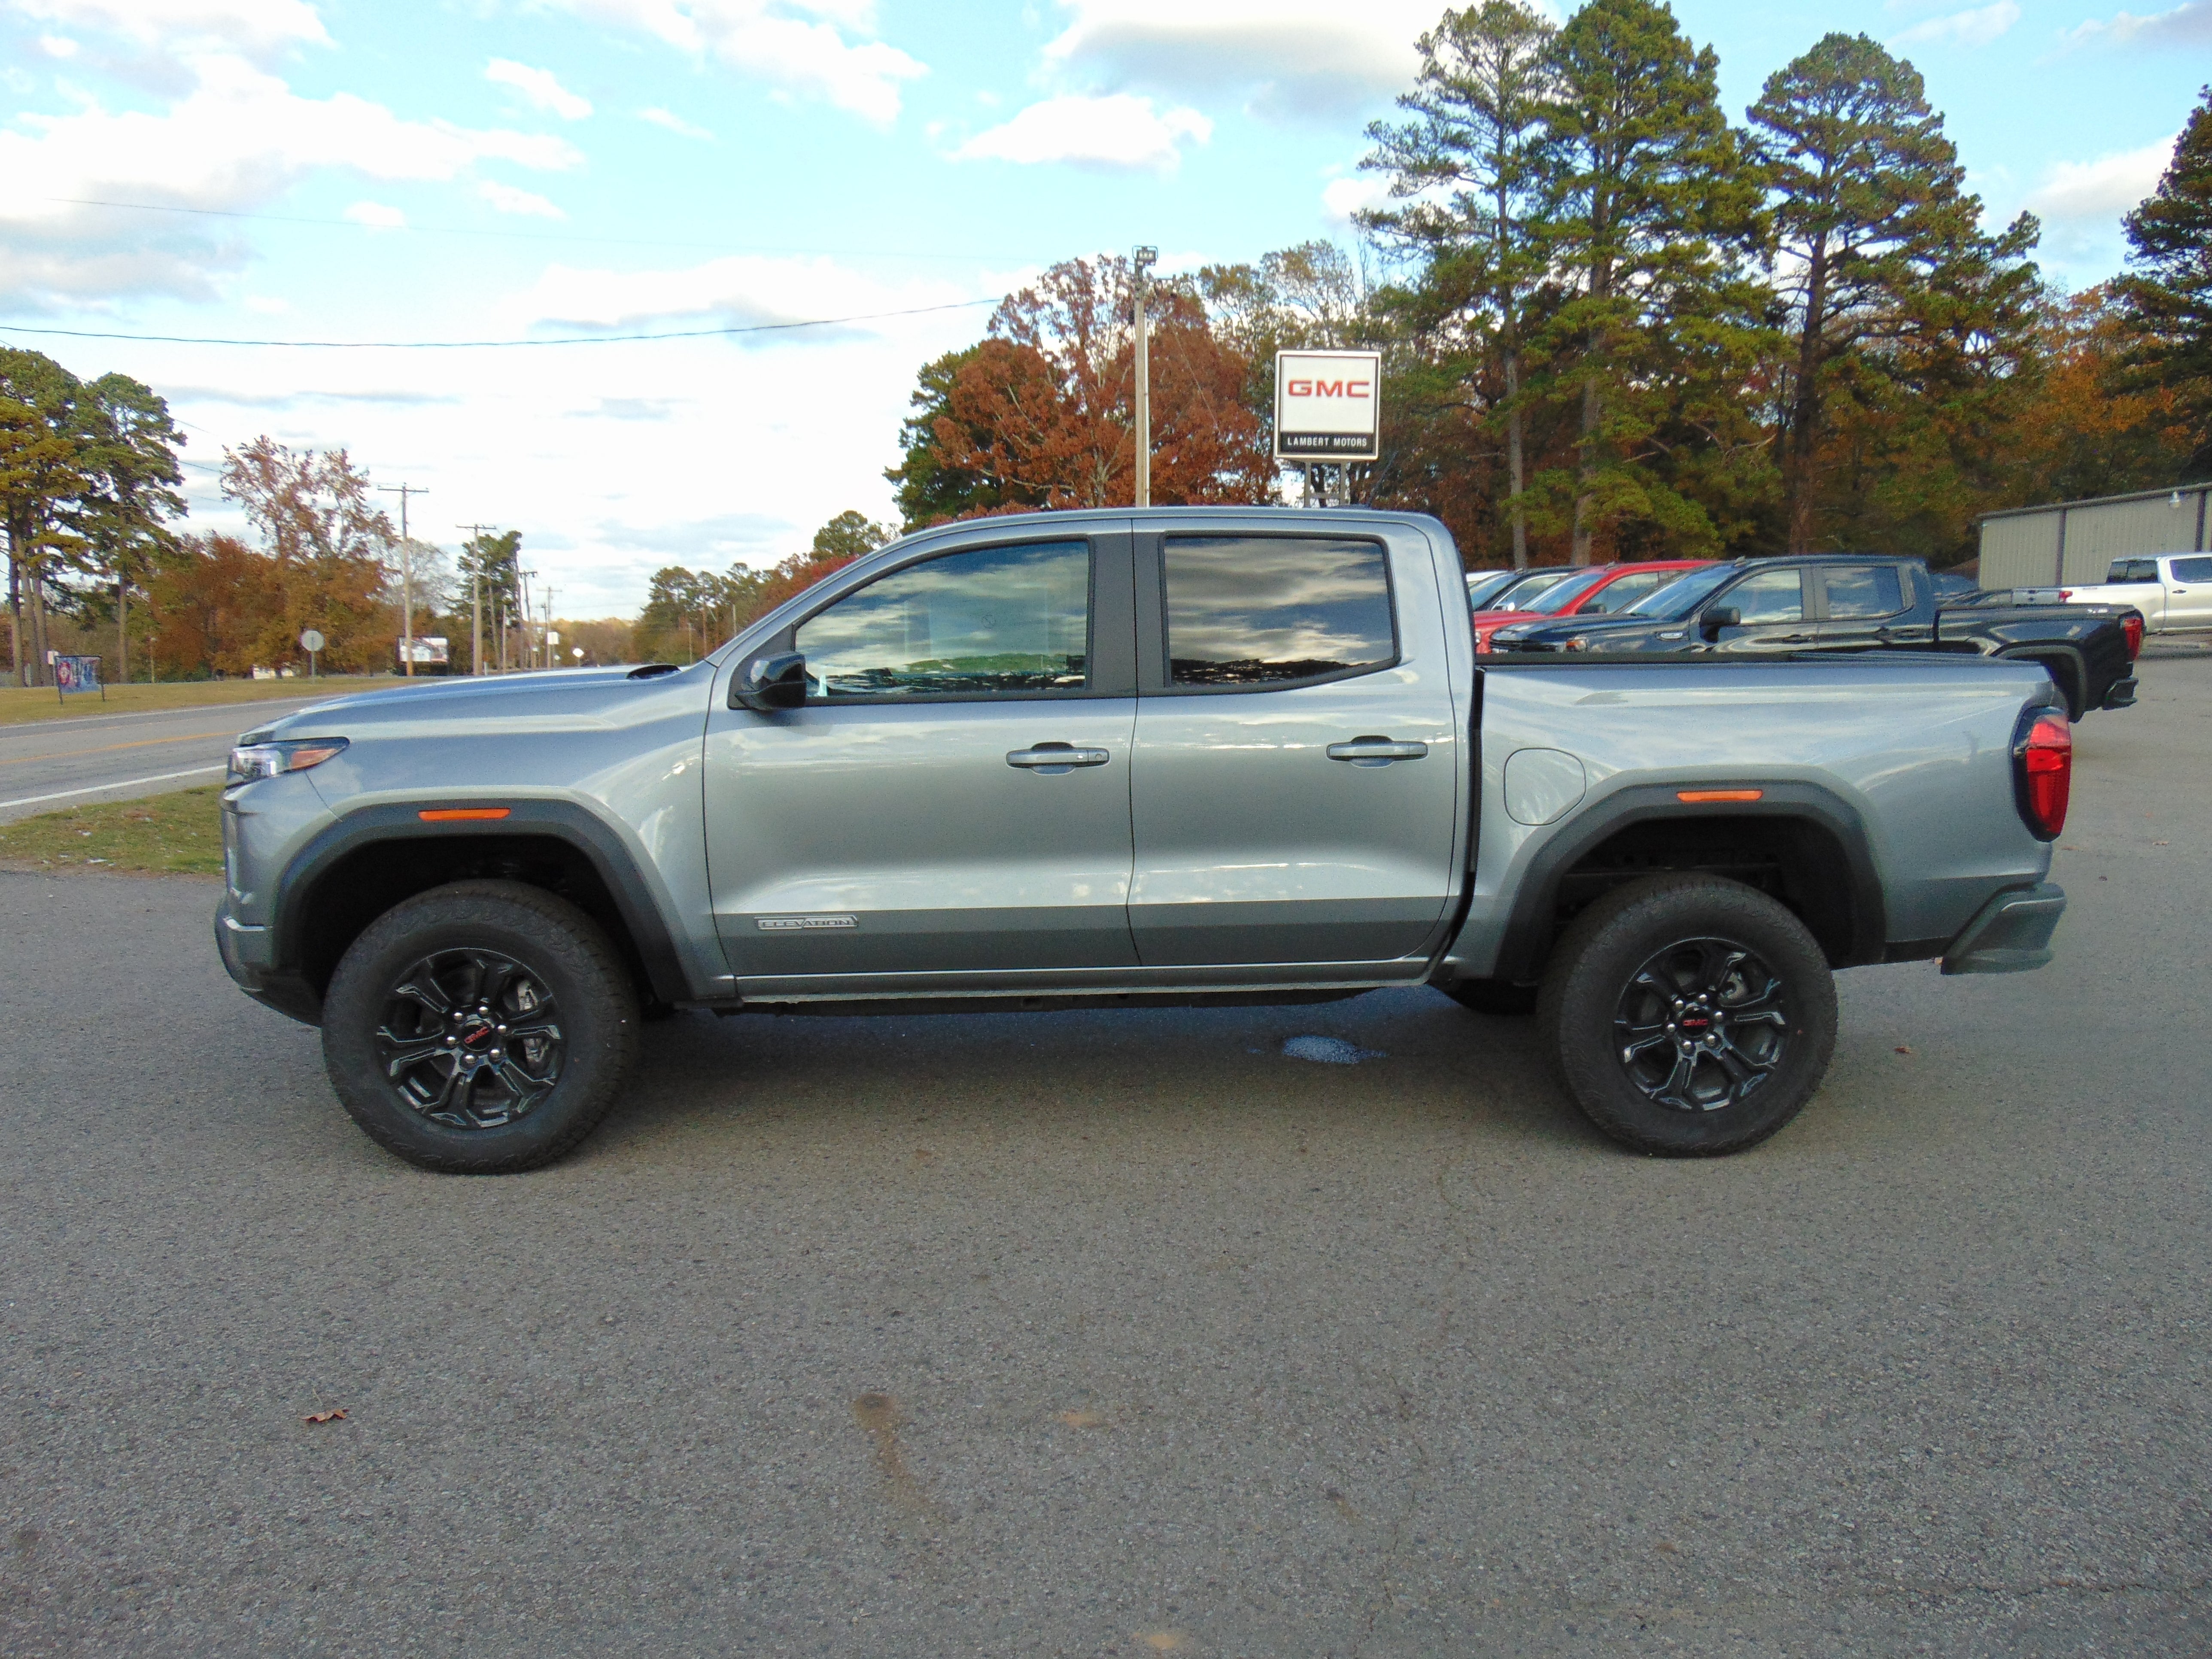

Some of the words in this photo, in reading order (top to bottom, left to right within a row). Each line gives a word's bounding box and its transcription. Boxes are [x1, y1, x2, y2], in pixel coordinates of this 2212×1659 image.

[1288, 380, 1369, 398] GMC
[1288, 437, 1329, 446] LAMBERT
[1334, 437, 1367, 447] MOTORS
[762, 918, 852, 928] ELEVATION
[464, 1026, 489, 1044] GMC
